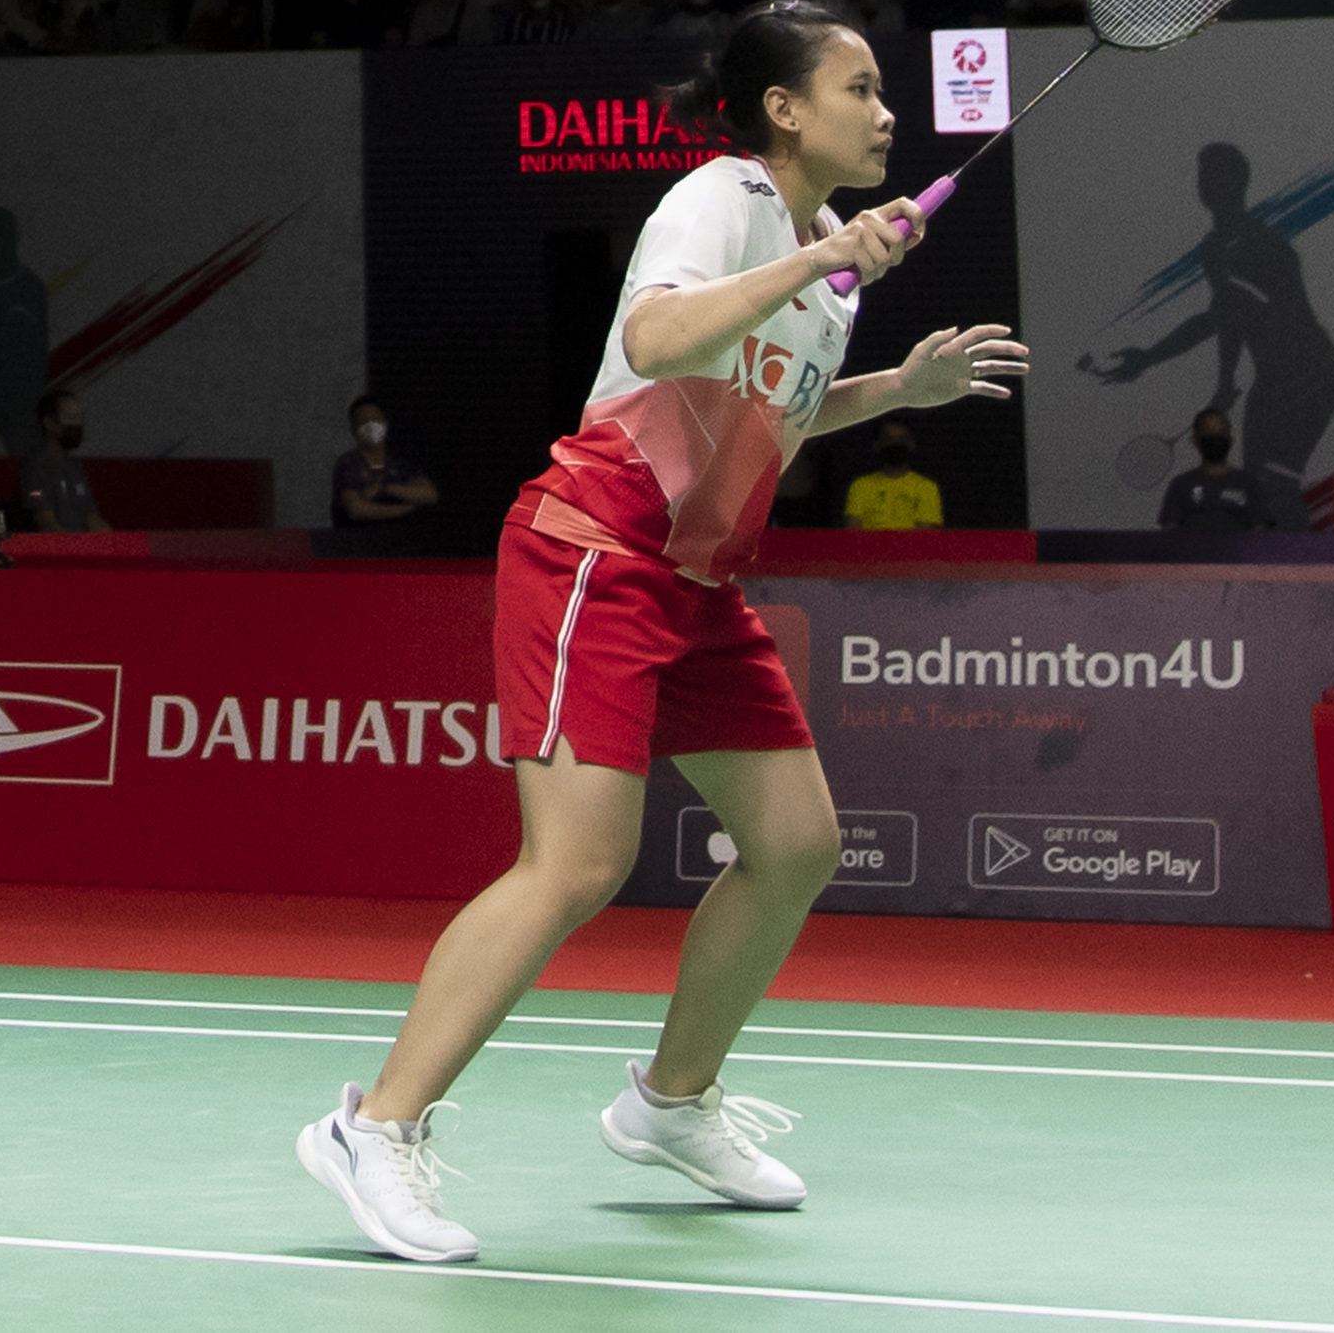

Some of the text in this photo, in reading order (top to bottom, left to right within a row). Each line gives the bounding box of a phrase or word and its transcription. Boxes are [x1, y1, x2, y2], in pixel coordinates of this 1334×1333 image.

[519, 151, 633, 173] INDONESIA
[841, 635, 1245, 690] Badminton4U
[838, 703, 1088, 733] Just A Touch Away
[851, 826, 877, 841] the
[1042, 826, 1119, 844] GET IT ON
[841, 847, 885, 869] ore
[1042, 846, 1202, 884] Google Play
